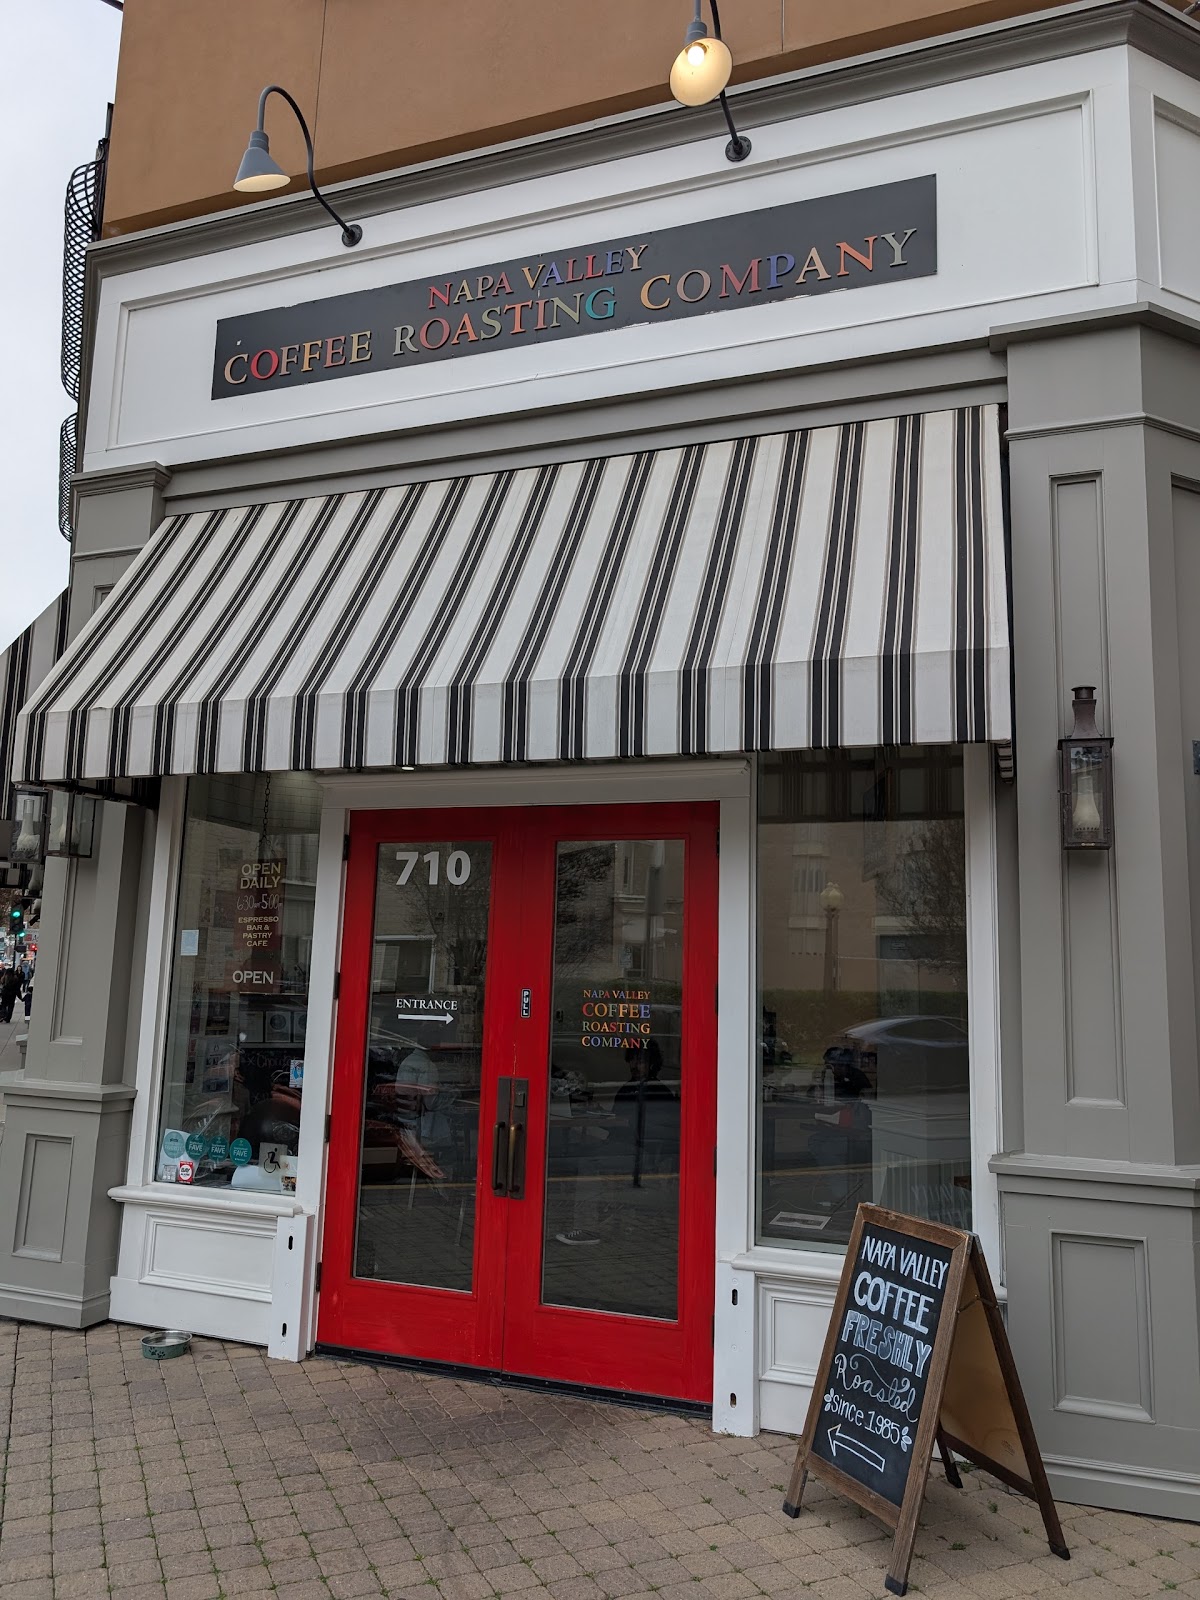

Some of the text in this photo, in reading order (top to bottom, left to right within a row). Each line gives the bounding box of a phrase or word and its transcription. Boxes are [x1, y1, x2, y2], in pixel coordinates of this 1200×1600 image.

[428, 244, 648, 309] NAPA VALLEY
[224, 228, 918, 385] COFFEE ROASTING COMPANY
[241, 862, 281, 876] OPEN
[396, 850, 471, 886] 710
[240, 876, 280, 889] DAILY
[232, 970, 274, 984] OPEN
[583, 989, 651, 1000] NAPA VALLEY
[396, 998, 458, 1011] ENTRANCE
[522, 990, 530, 1016] PULL
[582, 1002, 650, 1019] COFFEE
[582, 1021, 650, 1034] ROASTING
[581, 1036, 650, 1049] COMPANY
[188, 1144, 203, 1152] FAVE
[211, 1146, 226, 1154] FAVE
[233, 1149, 248, 1157] FAVE
[862, 1235, 949, 1290] NAPA VALLEY
[854, 1271, 935, 1335] COFFEE
[841, 1309, 932, 1379] FRESHLY
[834, 1353, 919, 1423] Roasted
[864, 1410, 901, 1445] 1985
